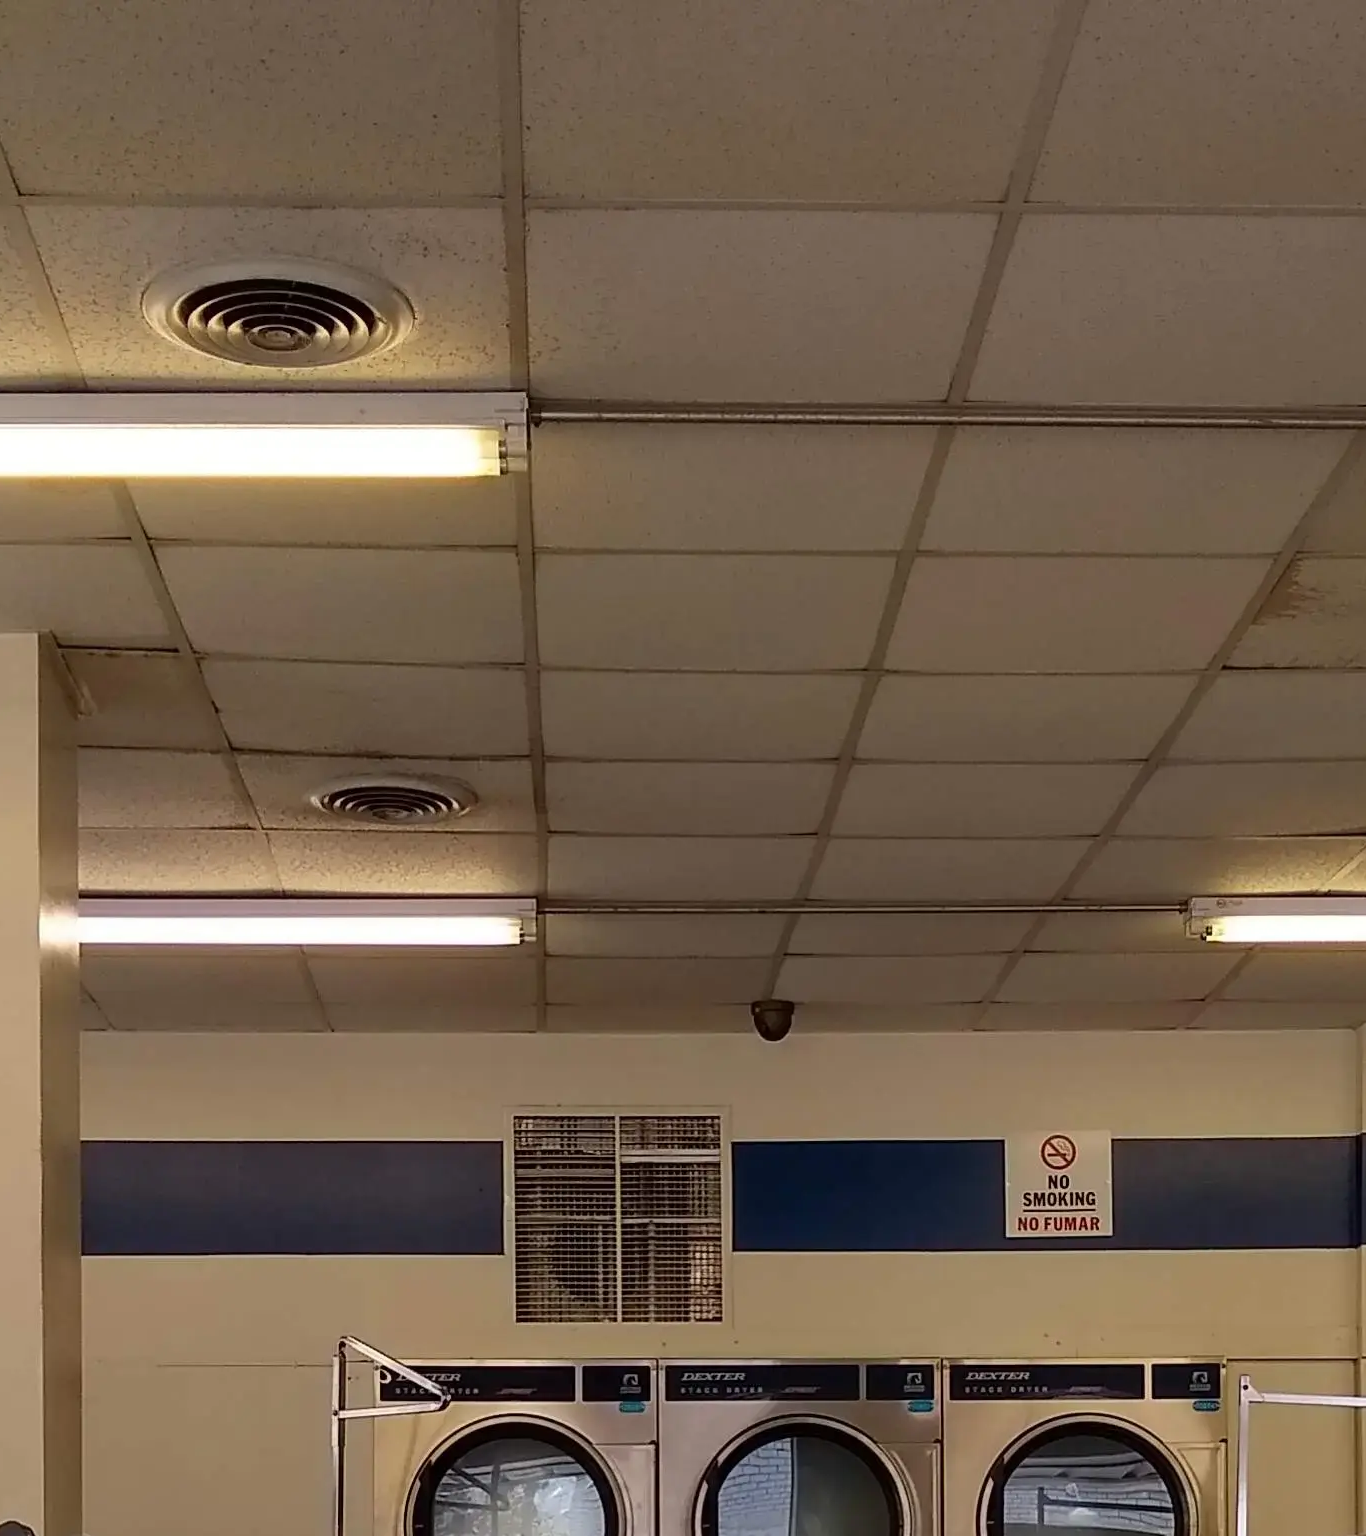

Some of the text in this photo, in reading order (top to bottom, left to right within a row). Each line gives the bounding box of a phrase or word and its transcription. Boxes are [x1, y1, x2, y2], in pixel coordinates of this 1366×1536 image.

[1048, 1174, 1070, 1190] NO
[1022, 1192, 1096, 1207] SMOKING
[1017, 1216, 1100, 1231] NO FUMAR
[681, 1372, 746, 1381] DEXTER
[965, 1371, 1030, 1381] DEXTER
